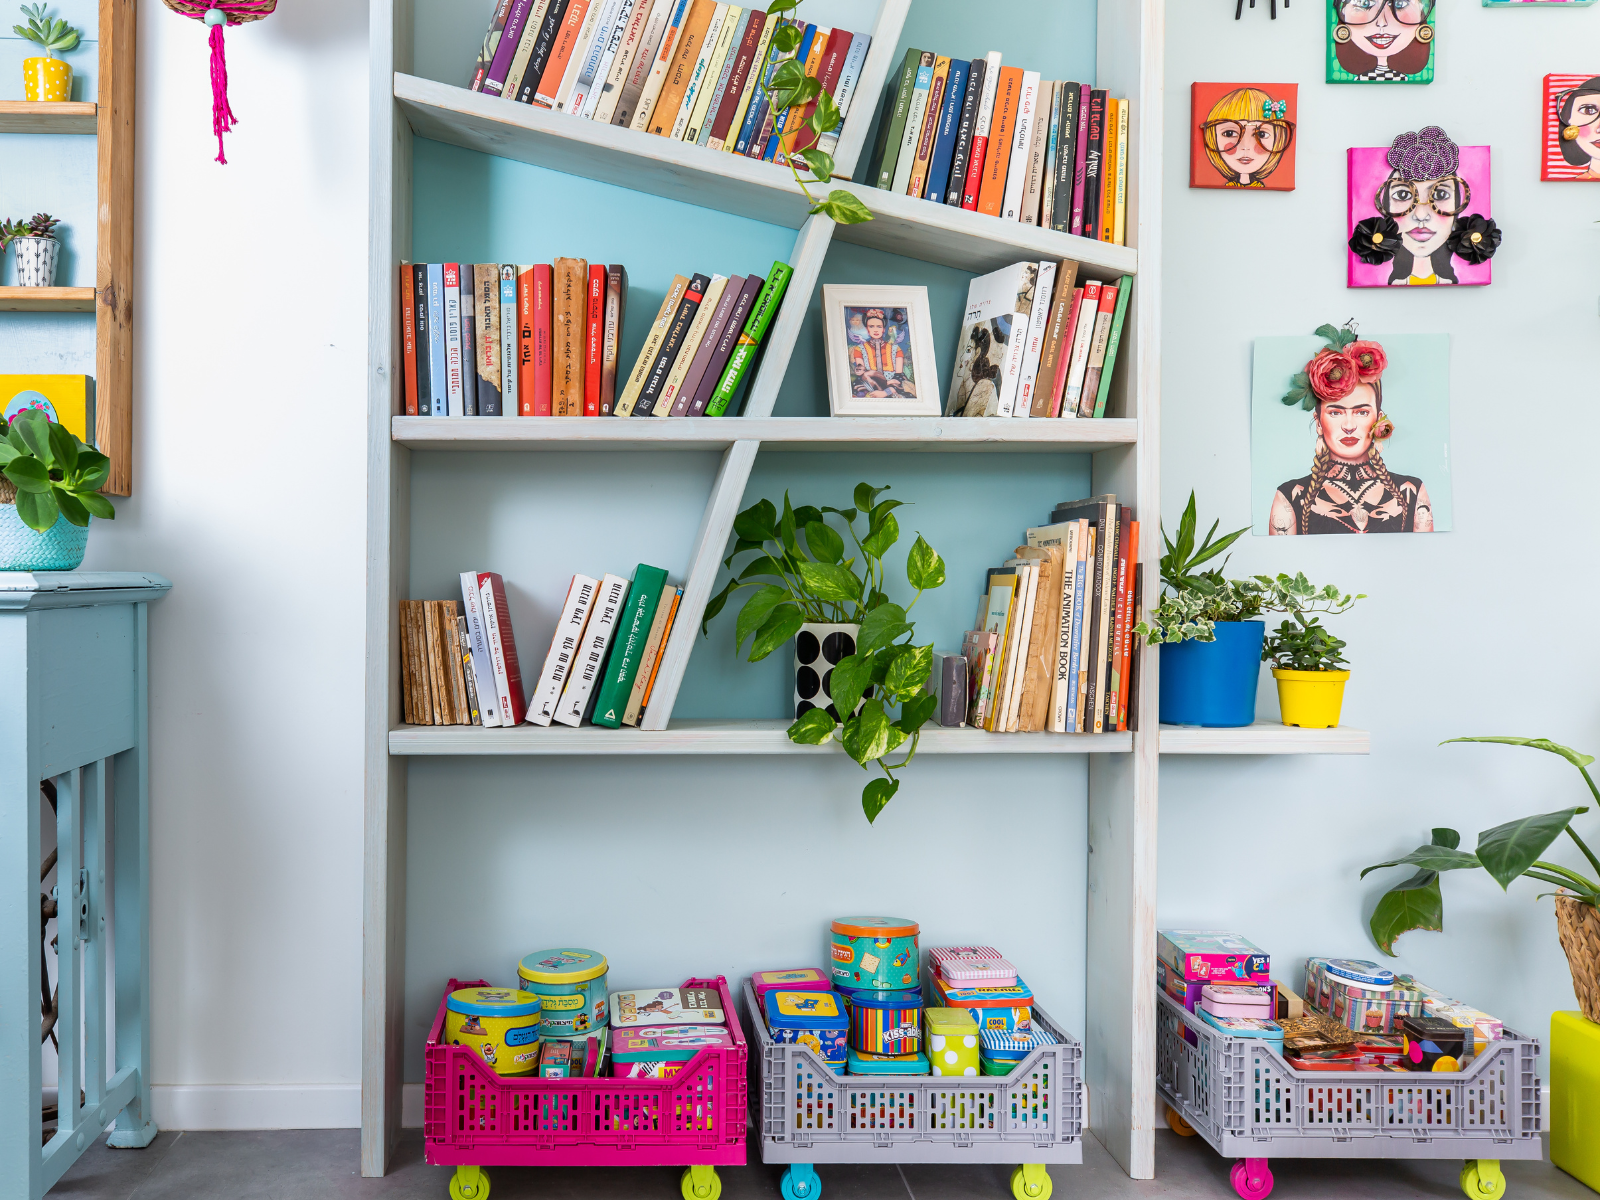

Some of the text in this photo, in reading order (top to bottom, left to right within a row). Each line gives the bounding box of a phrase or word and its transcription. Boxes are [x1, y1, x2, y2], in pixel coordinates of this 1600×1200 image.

[521, 20, 538, 53] הסגת גבול
[625, 11, 643, 47] באלדאצ'י
[584, 25, 609, 78] חיים בהמתנה
[619, 49, 630, 67] שבריר
[672, 34, 695, 86] מיכל שלו רחמים
[727, 46, 738, 63] הנזיר
[632, 47, 650, 85] צלה של הרוח
[721, 63, 732, 82] שמכר
[717, 83, 725, 94] את
[729, 74, 741, 95] ללא אם
[844, 74, 853, 88] רומן
[896, 67, 914, 118] יוסף בר יוסף תמרה
[709, 94, 721, 117] הפרארי
[752, 95, 760, 105] של
[943, 70, 962, 136] עדנה רומן משפחתי
[1066, 92, 1074, 113] אברהם
[703, 118, 713, 131] שלו
[746, 104, 757, 125] הדבורים
[953, 72, 978, 178] מיכל שלו מלאכי עליון
[1017, 101, 1031, 150] פיקו היעלמויות
[1090, 98, 1104, 140] ג'ון גרישם
[906, 133, 914, 147] אוני
[1031, 151, 1040, 175] שארית
[1062, 144, 1070, 164] השיבה
[970, 159, 979, 179] אהבה
[1118, 168, 1124, 176] את
[1028, 175, 1037, 194] החיים
[671, 282, 683, 300] מיכאל
[590, 298, 599, 319] מושלם
[482, 281, 493, 366] הסמל האבוד דן בראון
[522, 322, 531, 339] יום
[719, 293, 750, 353] מיכל שלו ממערב לירח
[1099, 324, 1107, 334] שלו
[448, 299, 460, 395] קארין פוסום הכלה ממומביי
[564, 341, 572, 359] מתות
[605, 320, 615, 362] עורבני חקיין
[683, 344, 692, 355] הבת
[1031, 337, 1039, 353] אחות
[1108, 330, 1119, 357] הנסיך הקטן
[522, 345, 531, 366] אחד
[654, 356, 668, 376] הפרס
[1008, 345, 1020, 377] צרויה שלו
[506, 369, 512, 378] של
[720, 348, 748, 394] צאו מזה!
[645, 374, 660, 396] הגדול
[1096, 544, 1104, 570] CONROY
[1063, 569, 1074, 591] THE
[1095, 570, 1103, 597] MADDOX
[1075, 589, 1083, 612] BOOK
[467, 585, 484, 653] מיכל שלו ימים בסערה
[1059, 592, 1072, 650] ANIMATION
[1124, 623, 1131, 632] של
[551, 583, 593, 682] מרגרט מיצ'ל חלף עם הרוח
[581, 582, 623, 681] מרגרט מיצ'ל חלף עם הרוח
[1073, 618, 1081, 651] Decorative
[1114, 623, 1122, 656] מתעורר
[1058, 651, 1068, 681] BOOK
[1071, 651, 1079, 674] Borders
[633, 673, 648, 692] Key
